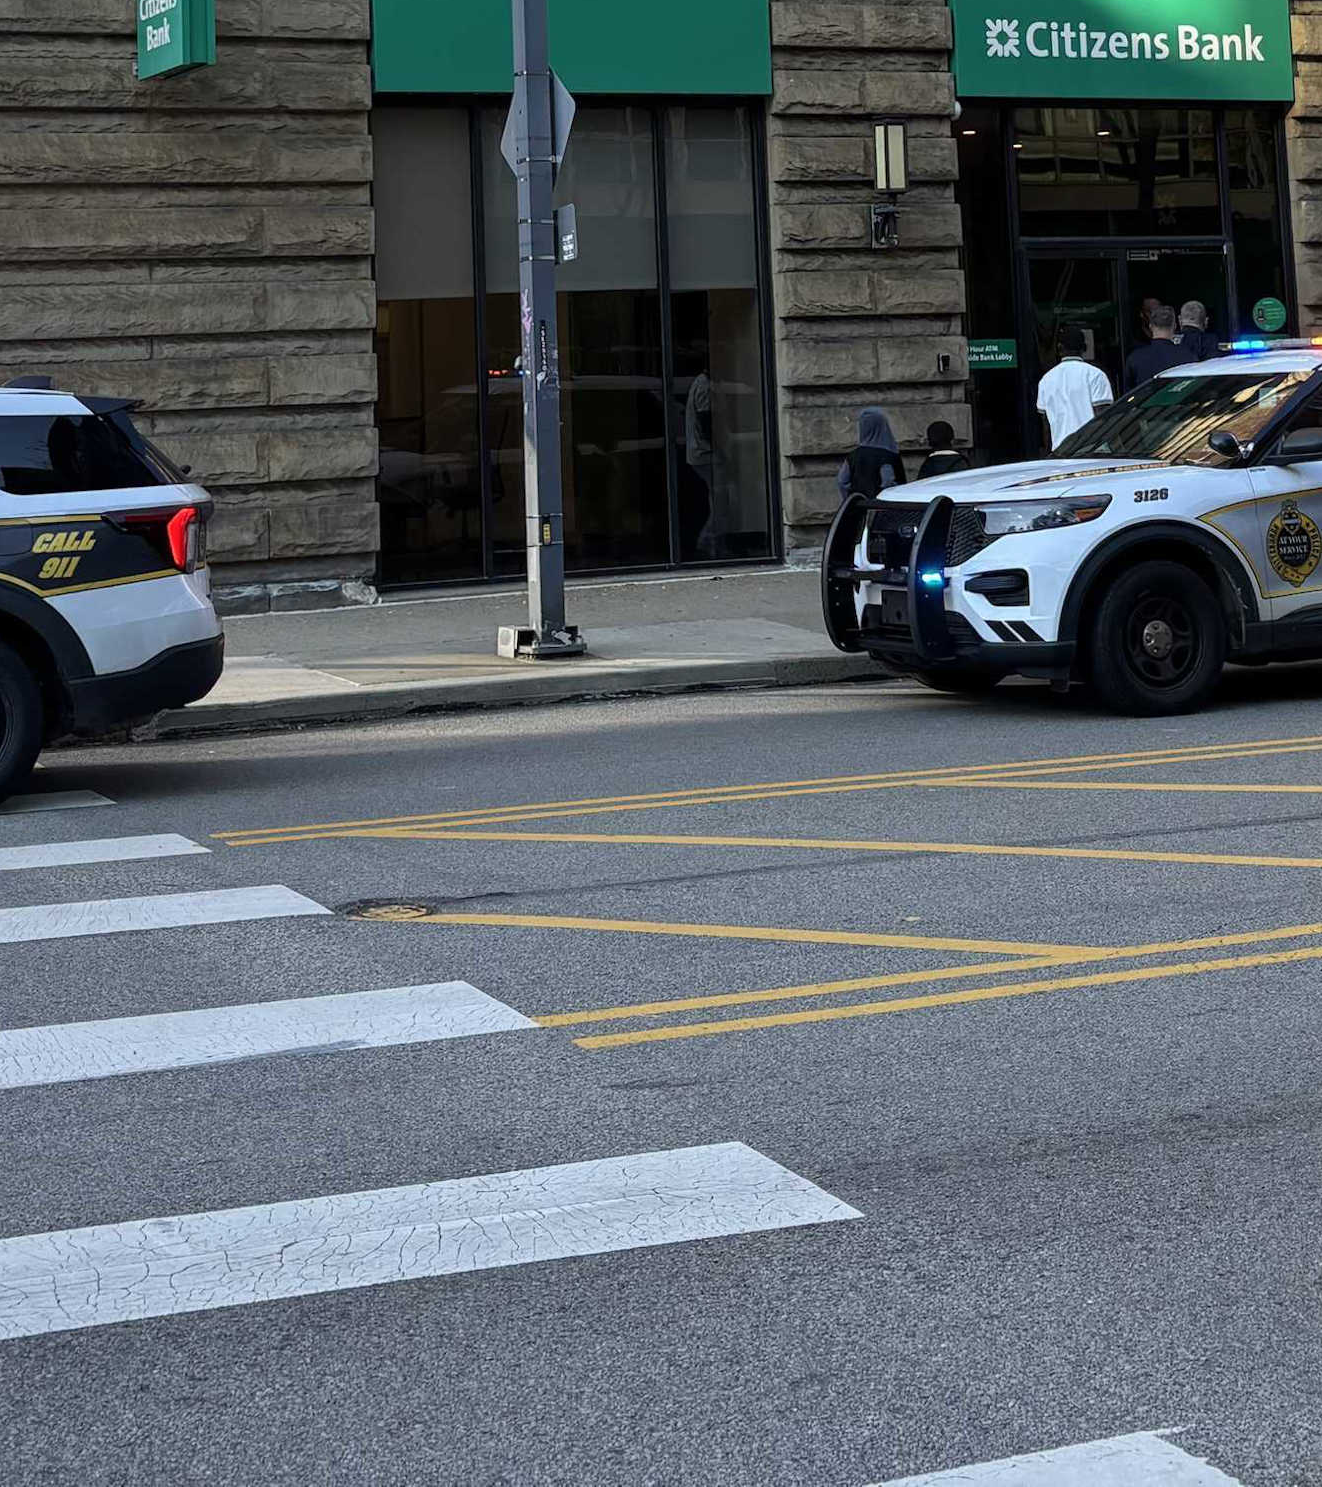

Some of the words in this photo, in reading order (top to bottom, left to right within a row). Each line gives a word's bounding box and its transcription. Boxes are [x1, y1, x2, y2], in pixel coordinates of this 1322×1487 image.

[146, 17, 171, 51] Bank
[1025, 21, 1170, 60] Citizens
[1177, 23, 1265, 62] Bank
[980, 353, 995, 362] Bank
[995, 352, 1013, 362] Lobby
[1133, 488, 1169, 503] 3126
[32, 530, 97, 554] CALL
[38, 556, 81, 579] 911
